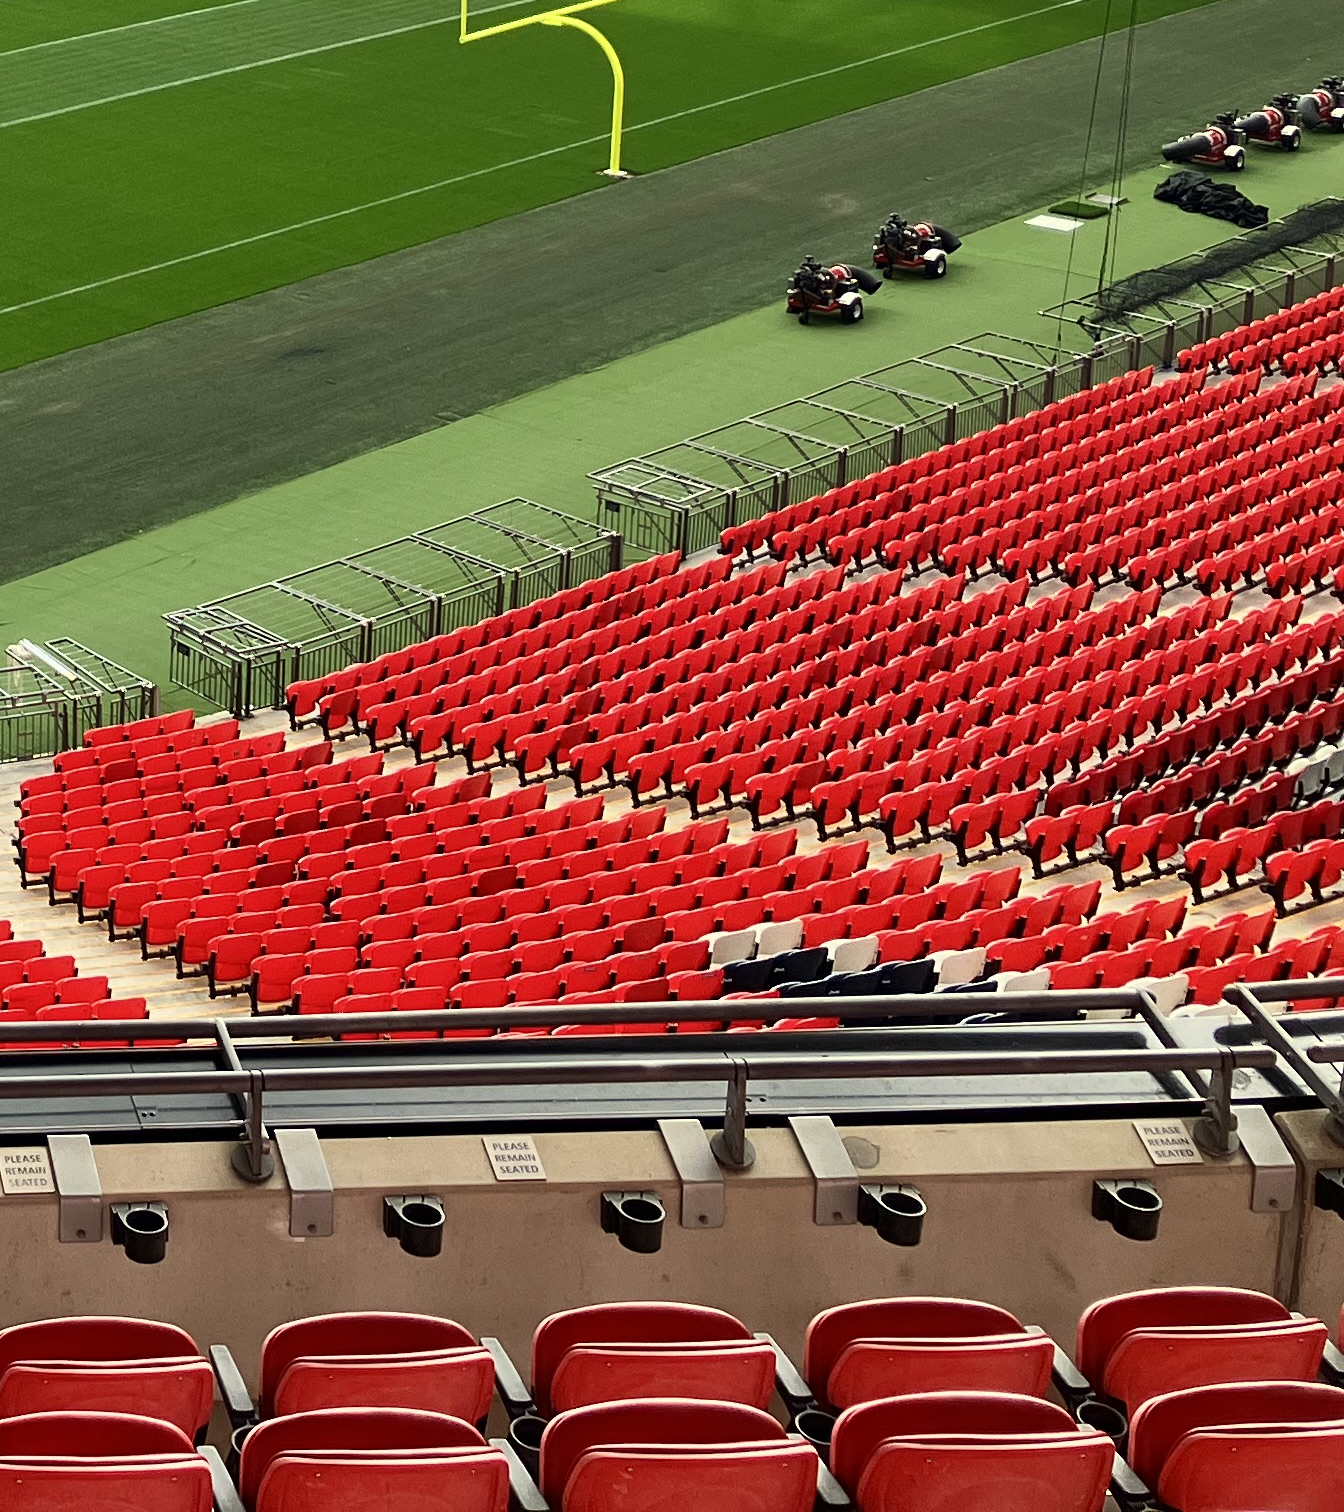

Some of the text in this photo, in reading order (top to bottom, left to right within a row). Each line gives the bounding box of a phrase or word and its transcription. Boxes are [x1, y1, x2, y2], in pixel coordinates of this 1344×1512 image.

[1143, 1127, 1181, 1135] PLEASE
[1147, 1137, 1190, 1146] REMAIN
[492, 1142, 530, 1150] PLEASE
[1154, 1149, 1194, 1158] SEATED
[4, 1154, 42, 1163] PLEASE
[494, 1154, 536, 1162] REMAIN
[4, 1167, 47, 1175] REMAIN
[499, 1165, 539, 1173] SEATED
[8, 1178, 48, 1187] SEATED
